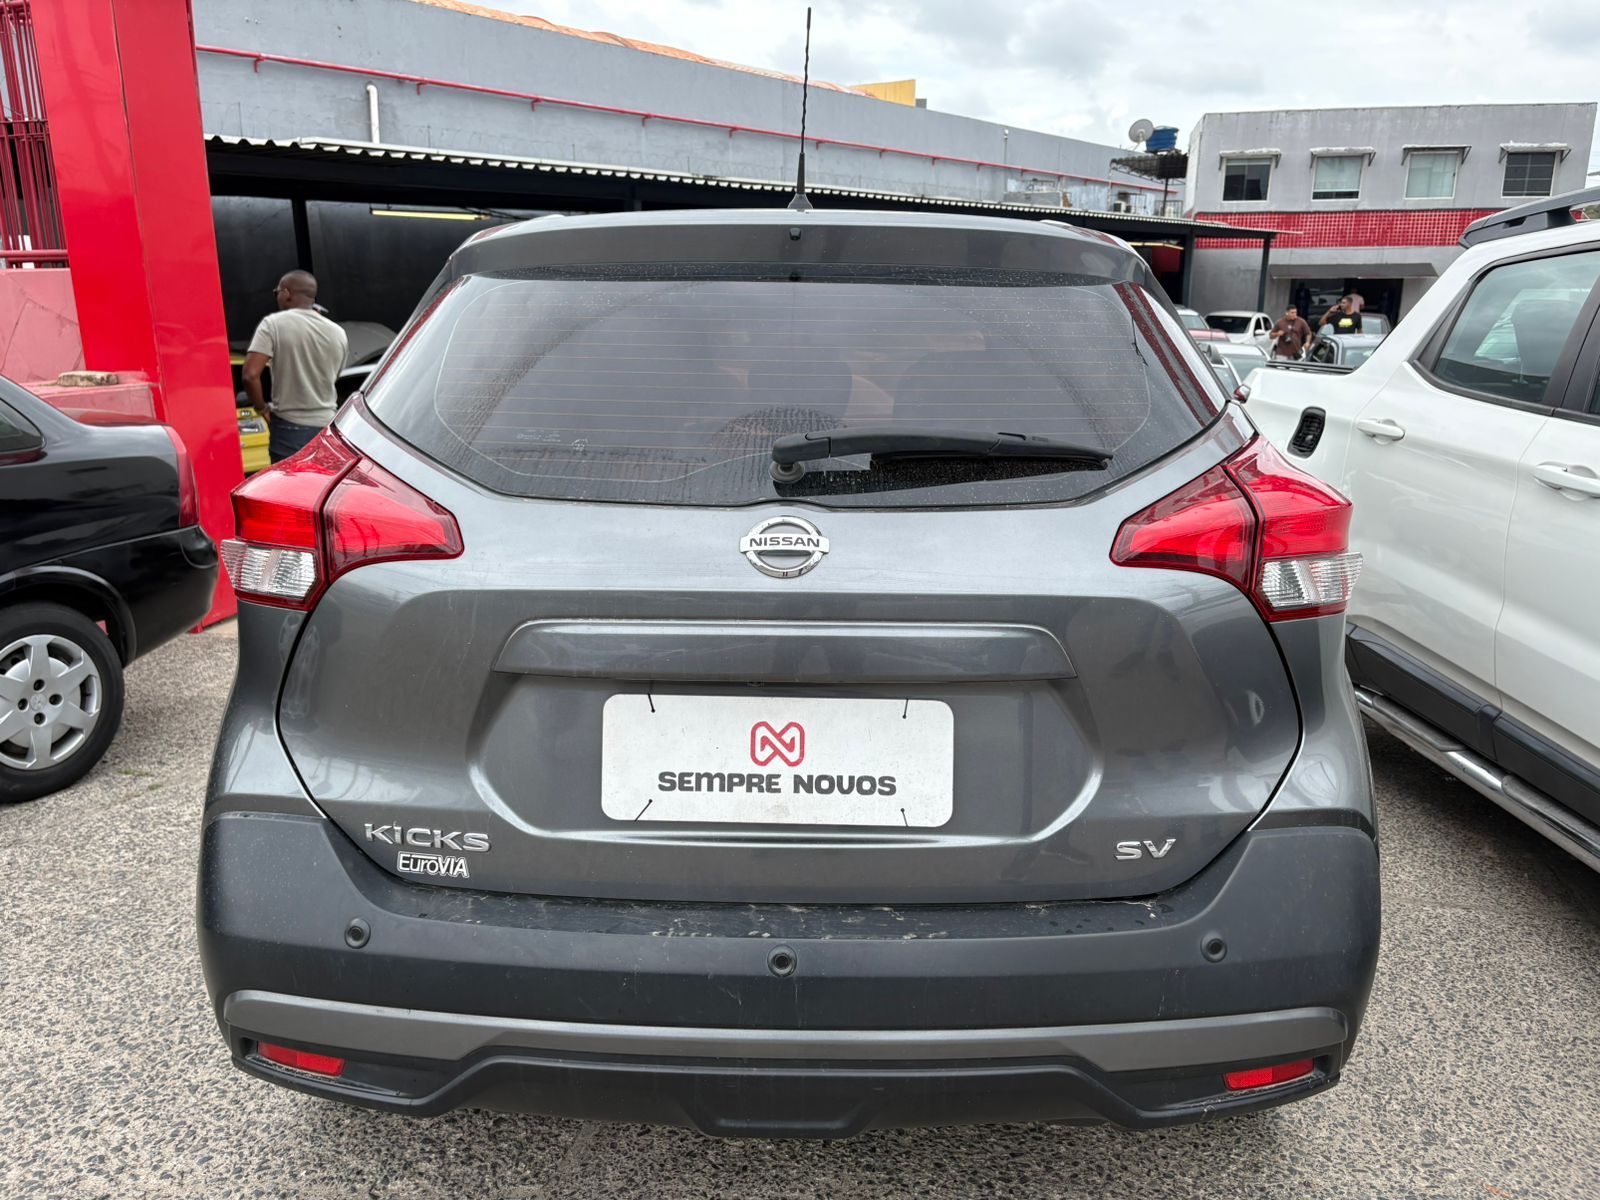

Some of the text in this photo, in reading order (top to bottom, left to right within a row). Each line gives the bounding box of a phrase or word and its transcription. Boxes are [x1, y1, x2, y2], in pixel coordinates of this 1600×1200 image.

[749, 536, 820, 548] NISSAN
[658, 771, 897, 796] SEMPRE NOVOS
[1115, 838, 1177, 860] SV
